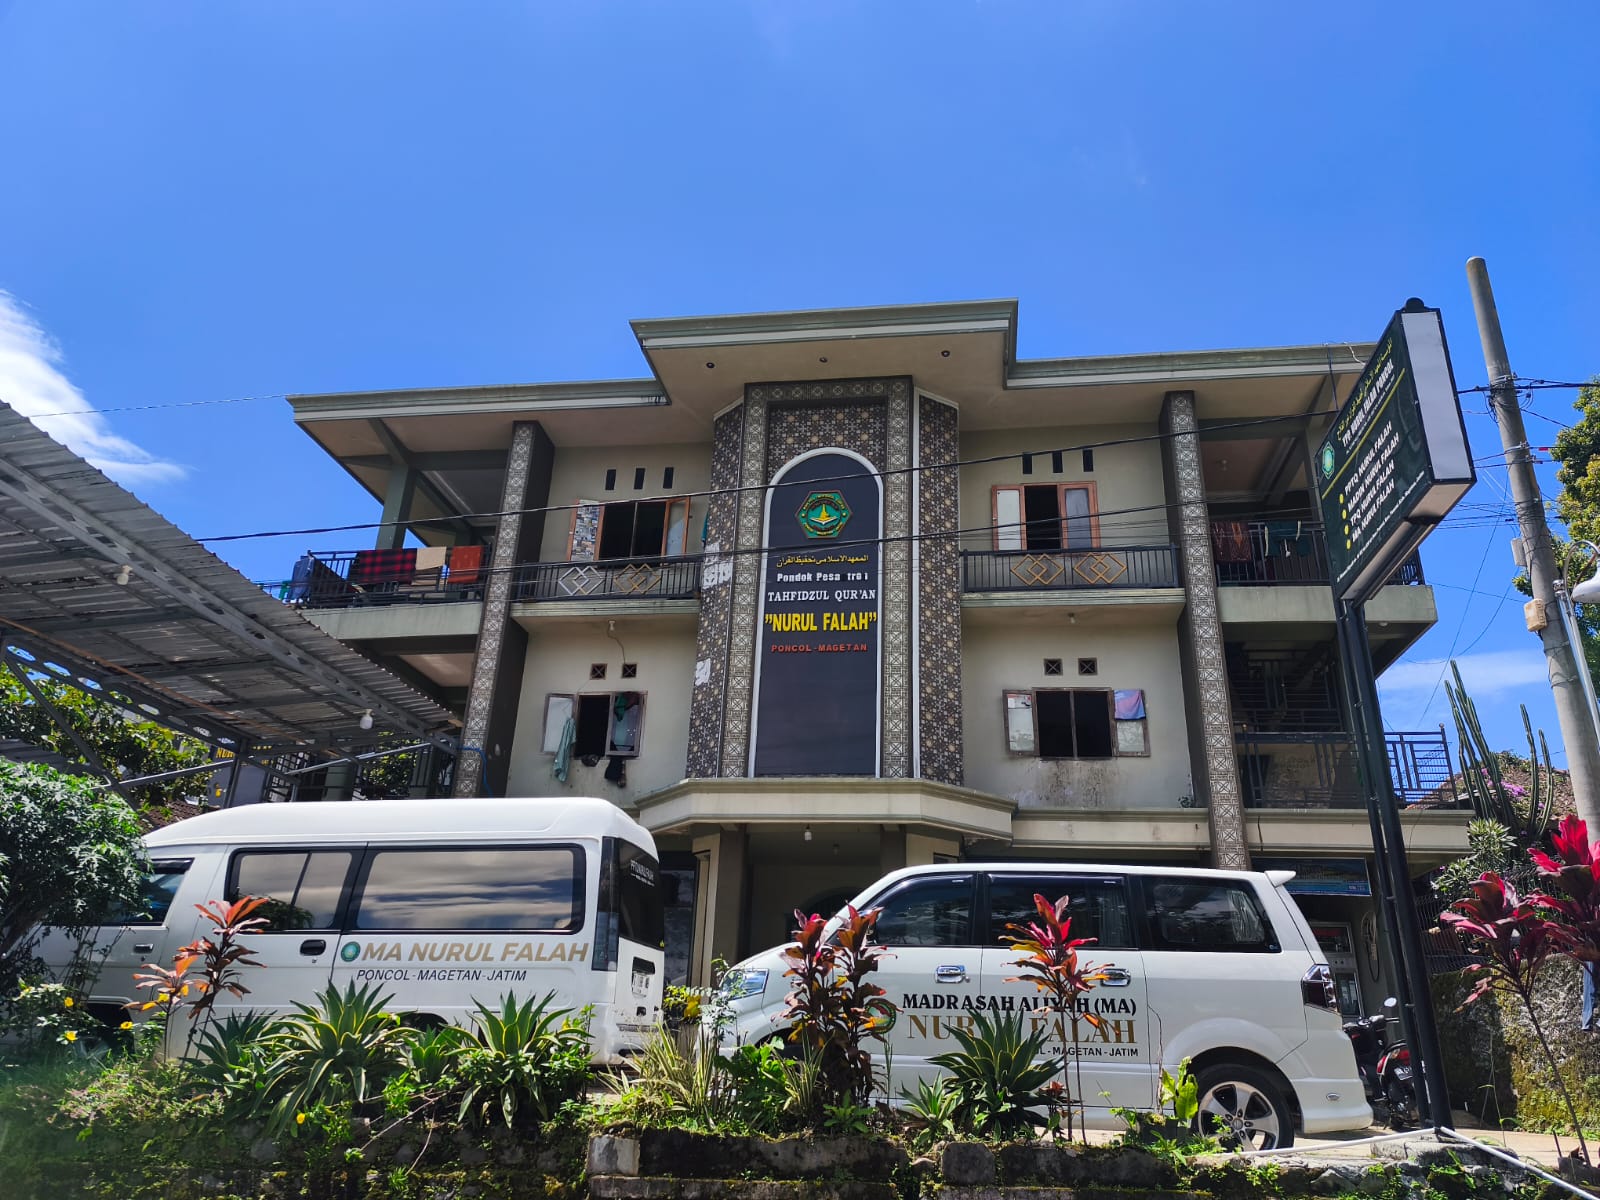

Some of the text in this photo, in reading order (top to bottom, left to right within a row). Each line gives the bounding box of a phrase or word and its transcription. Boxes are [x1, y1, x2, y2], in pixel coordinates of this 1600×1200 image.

[1345, 473, 1358, 495] PPTQ
[1358, 448, 1375, 477] NURUL
[1374, 420, 1392, 452] FALAH
[1364, 459, 1381, 488] NURUL
[1380, 432, 1399, 464] FALAH
[1361, 485, 1376, 513] NURUL
[1375, 459, 1394, 490] FALAH
[1361, 503, 1377, 530] NURUL
[1376, 478, 1394, 508] FALAH
[777, 572, 813, 582] Pondok
[767, 589, 876, 602] TAHFIDZUL QUR'AN
[771, 644, 812, 652] PONCOL
[818, 643, 867, 652] MAGETAN
[361, 942, 589, 962] MA NURUL FALAH
[356, 969, 410, 981] PONCOL
[417, 969, 481, 981] MAGETAN
[487, 970, 527, 981] JATIM
[902, 993, 1015, 1011] MADRASAH
[1094, 998, 1136, 1016] (MA)
[1109, 1047, 1139, 1057] JATIM
